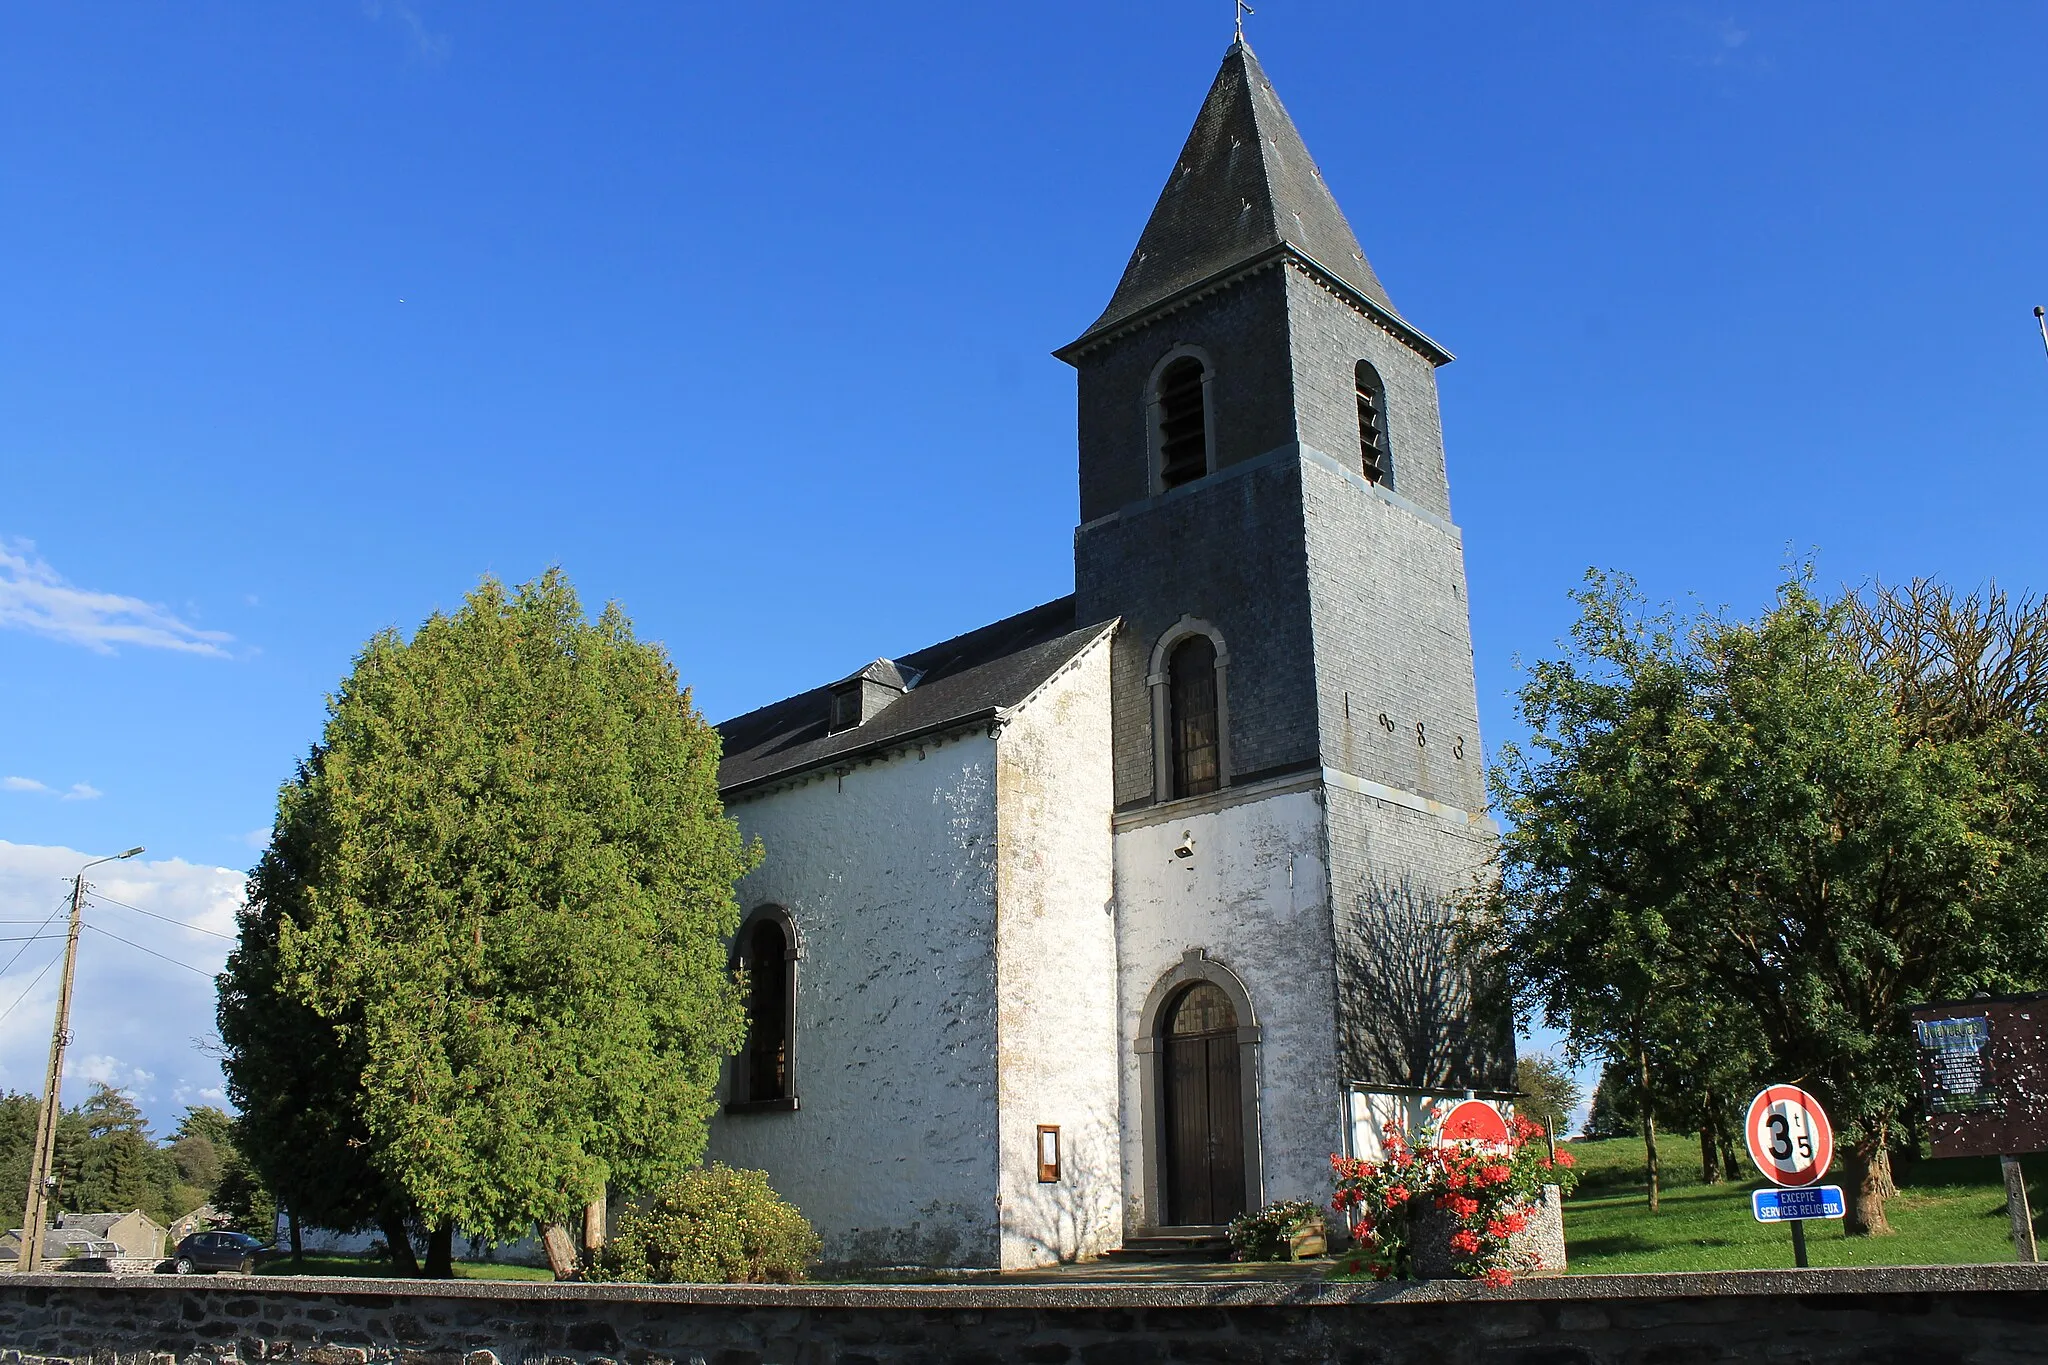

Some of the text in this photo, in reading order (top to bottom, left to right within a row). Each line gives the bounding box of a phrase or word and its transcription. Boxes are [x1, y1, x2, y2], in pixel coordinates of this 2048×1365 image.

[1781, 1191, 1815, 1204] EXCEPTE
[1760, 1203, 1839, 1218] SERVICES RELIGIEUX
